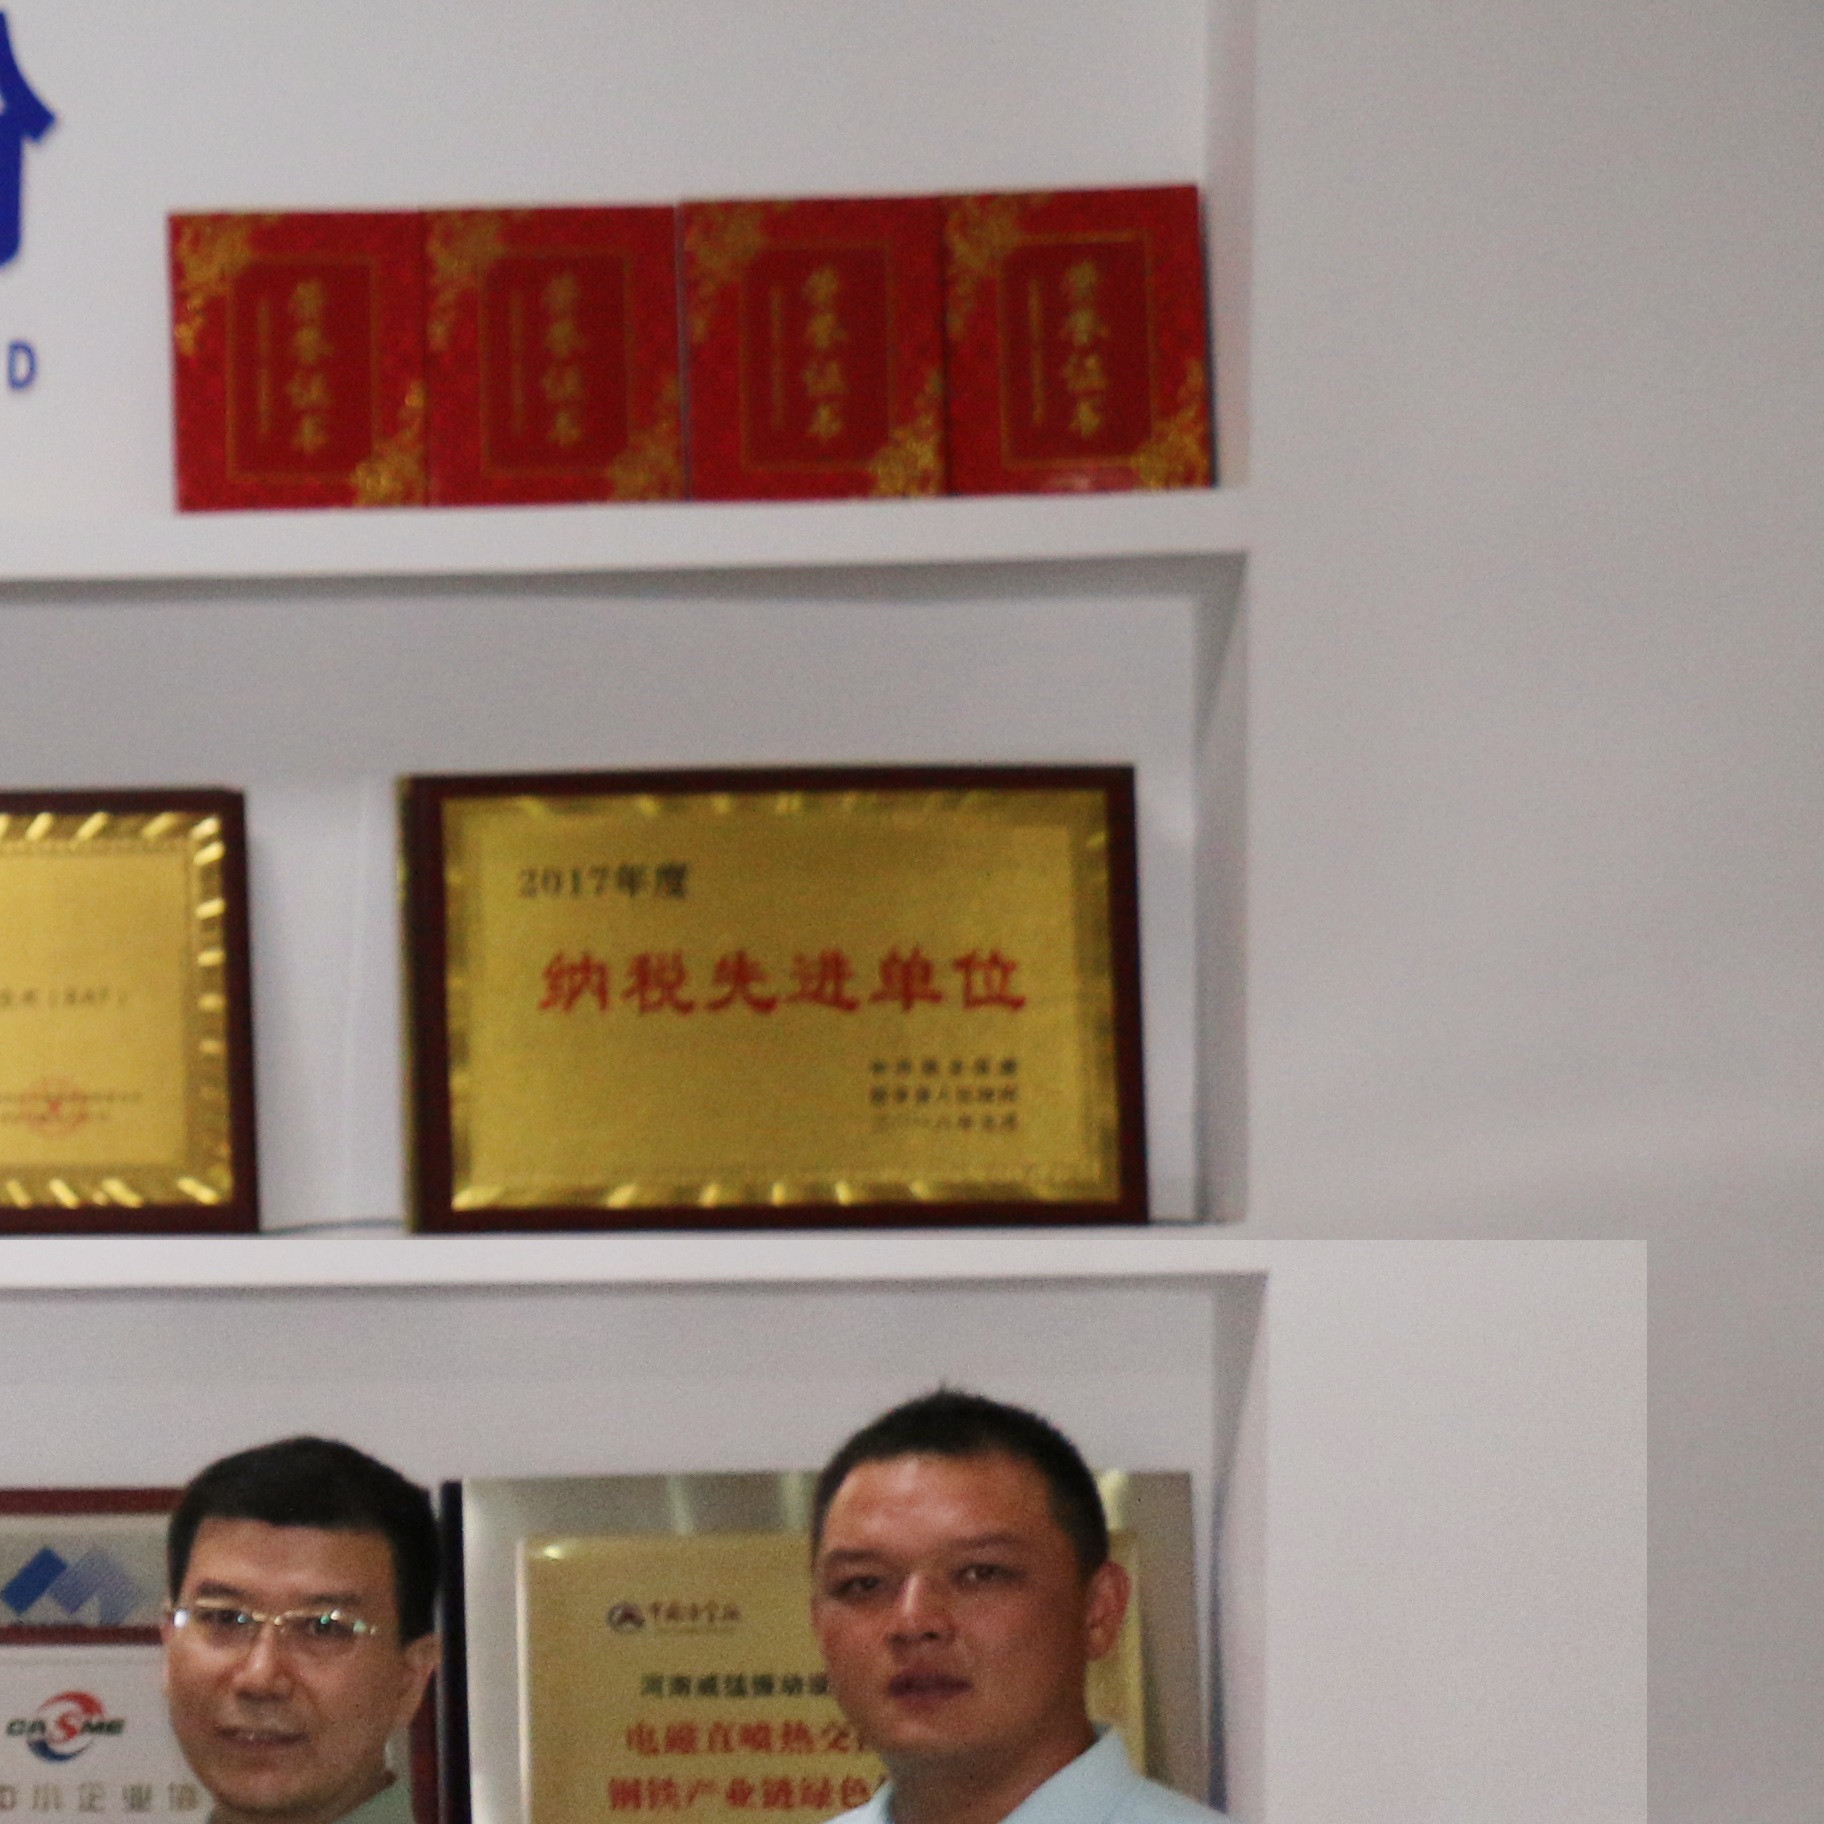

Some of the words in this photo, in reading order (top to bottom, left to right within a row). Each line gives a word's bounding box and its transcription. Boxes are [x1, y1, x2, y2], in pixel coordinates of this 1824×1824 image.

[518, 863, 689, 899] 2017年度
[538, 945, 1025, 1014] 纳税先进单位
